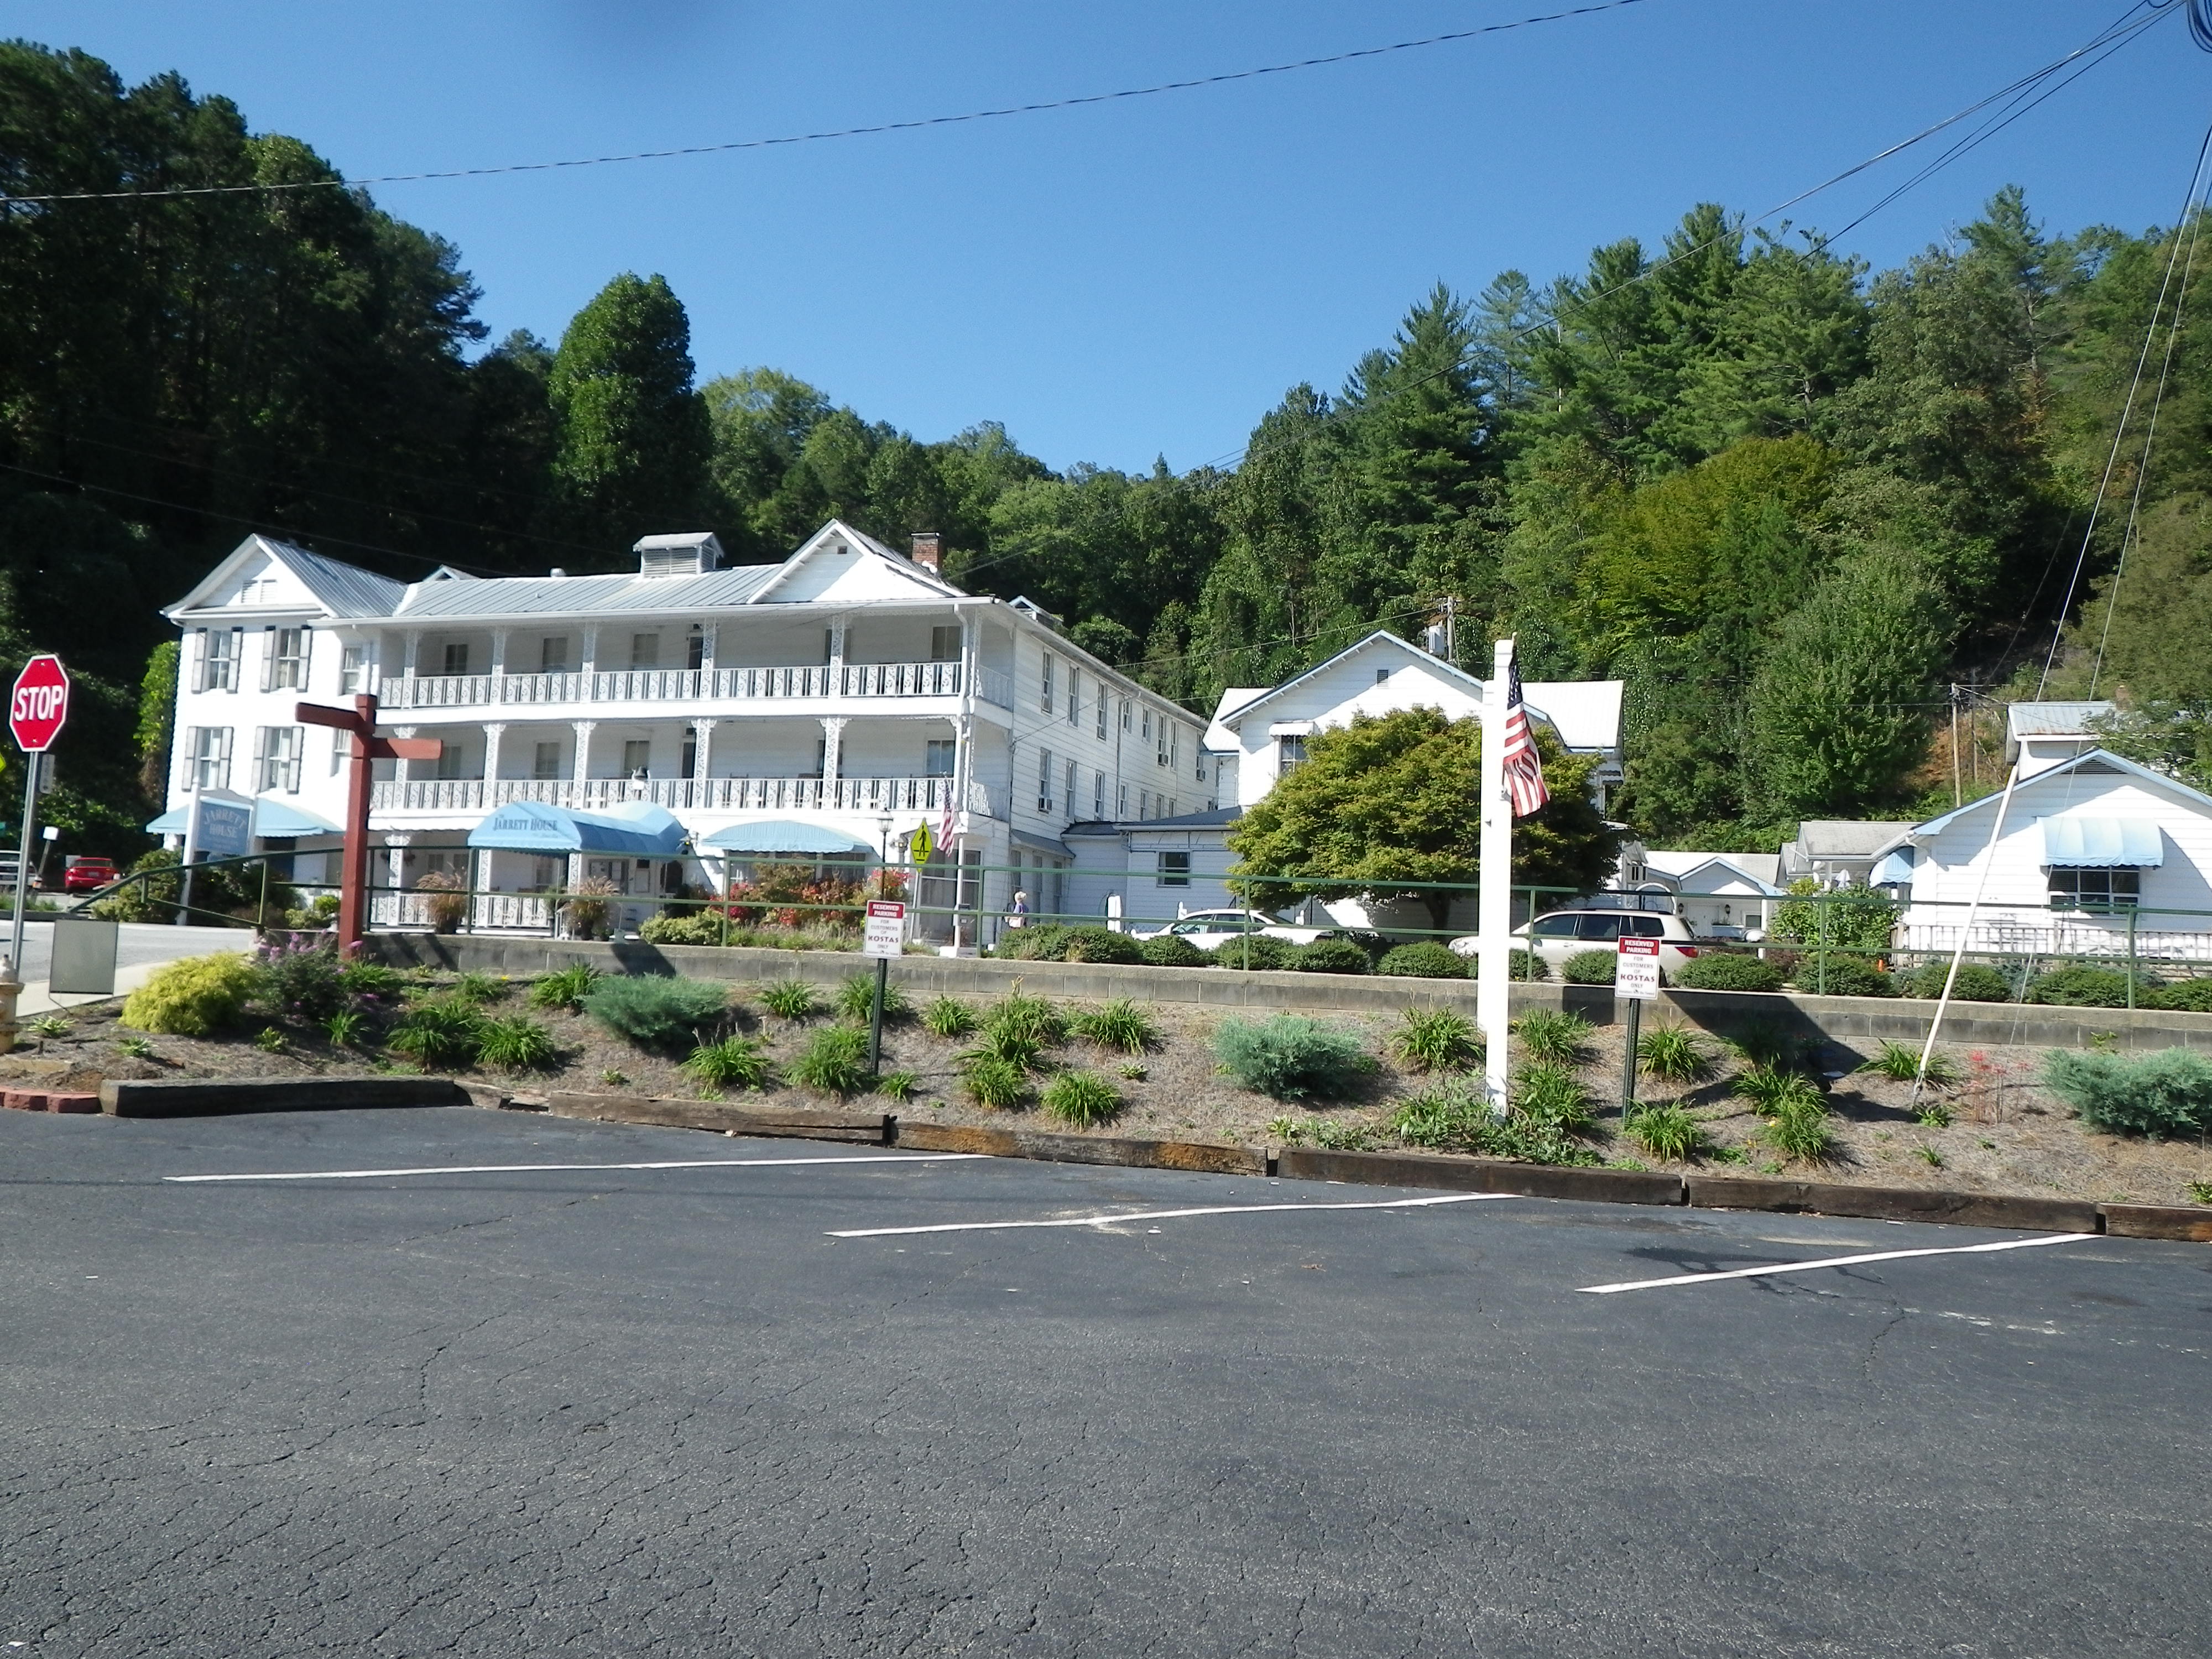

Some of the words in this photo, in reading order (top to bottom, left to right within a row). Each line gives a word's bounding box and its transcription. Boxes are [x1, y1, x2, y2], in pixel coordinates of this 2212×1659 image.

[15, 685, 64, 721] STOP
[204, 808, 247, 829] JARRETT
[493, 817, 529, 831] JARRETT
[531, 818, 557, 831] HOUSE
[209, 823, 238, 838] HOUSE
[1620, 974, 1655, 982] KOSTAS
